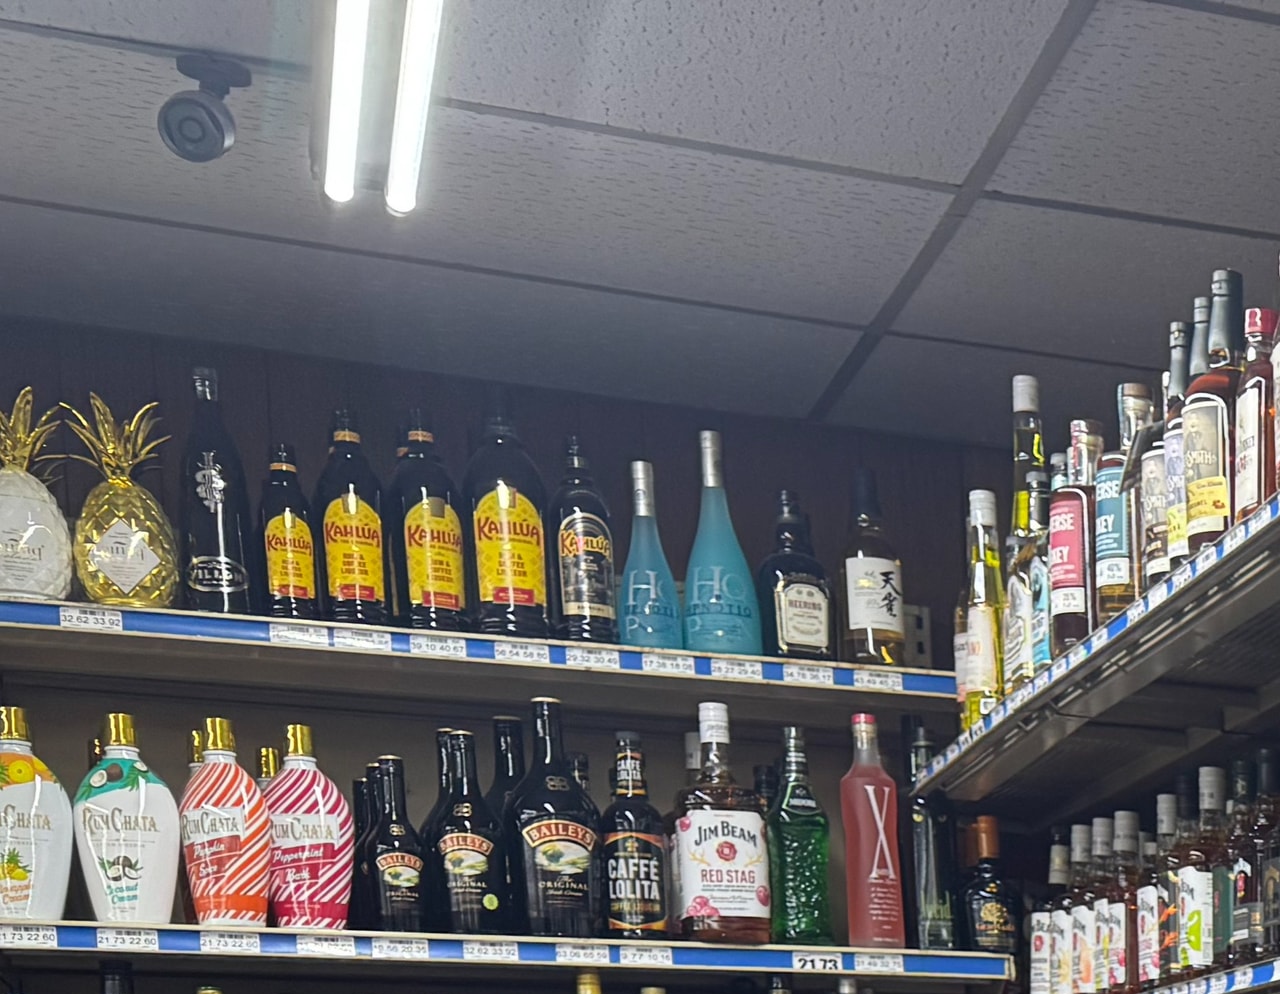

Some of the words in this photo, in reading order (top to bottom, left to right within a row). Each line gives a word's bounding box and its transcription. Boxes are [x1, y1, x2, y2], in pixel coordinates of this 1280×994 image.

[529, 821, 593, 845] BAILEYS
[694, 823, 719, 847] JIM
[721, 820, 757, 847] BEAM
[608, 856, 659, 880] CAFFÉ
[701, 869, 723, 883] RED
[726, 871, 755, 884] STAG
[609, 879, 659, 901] LOLITA
